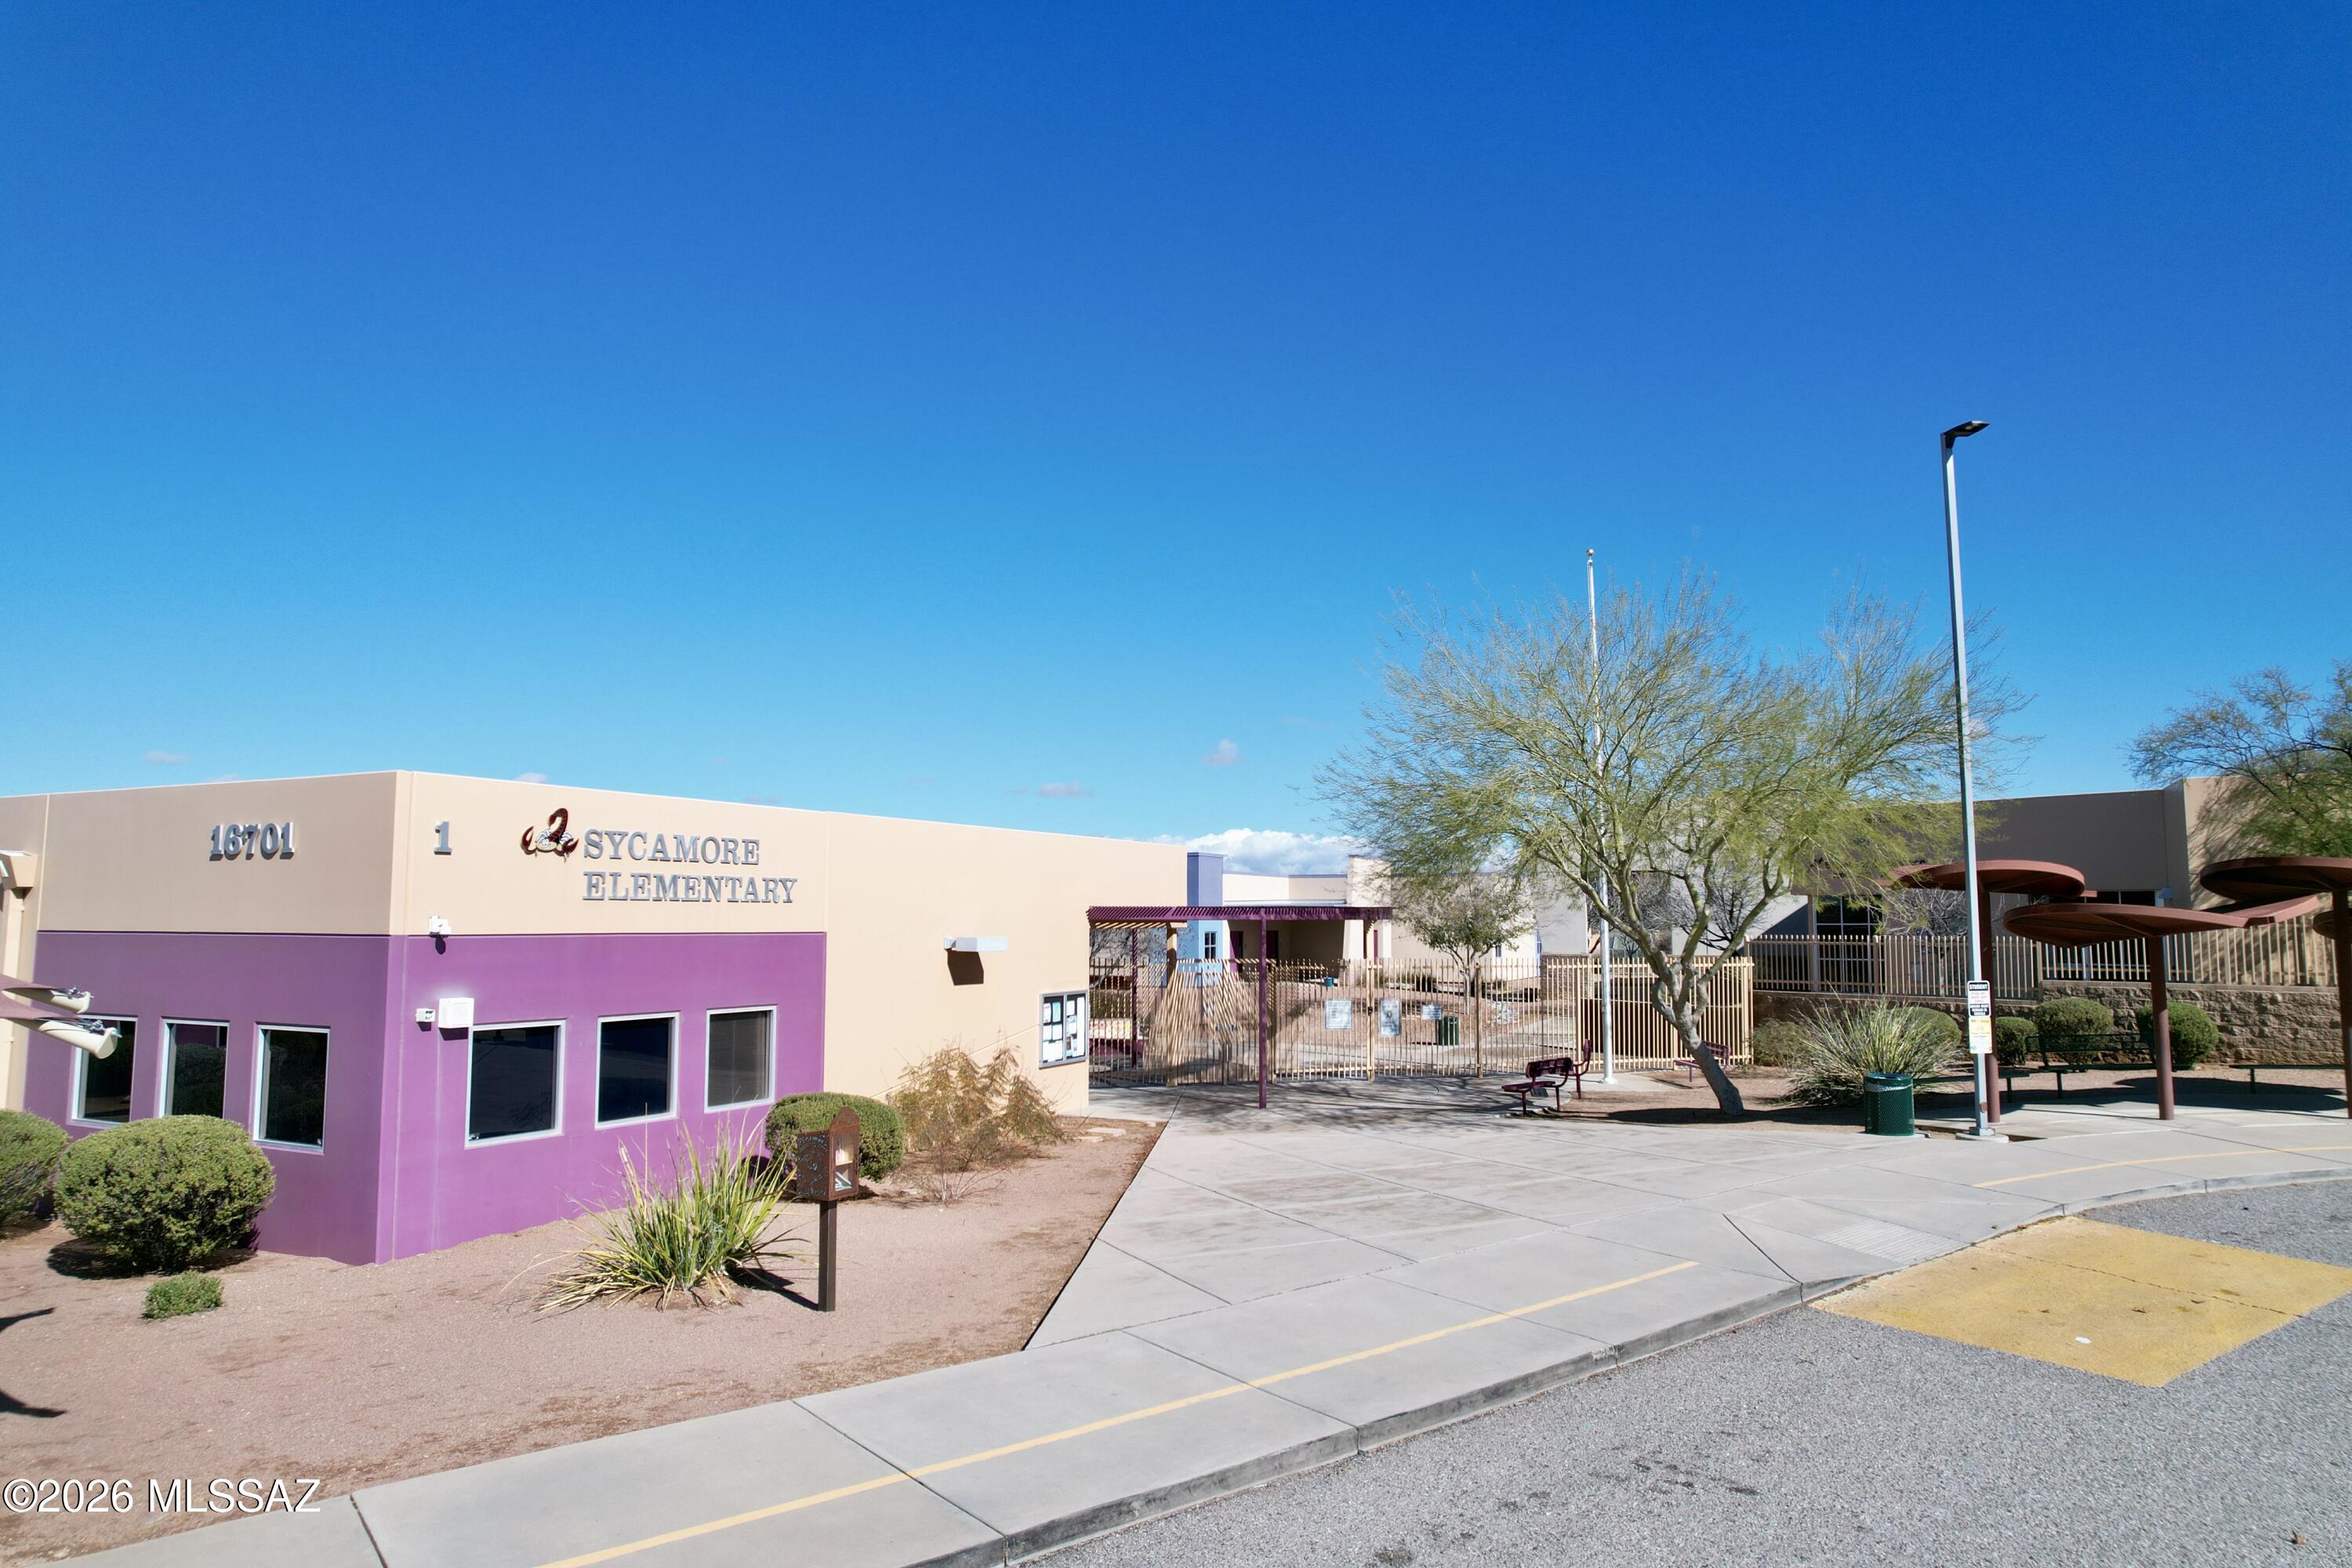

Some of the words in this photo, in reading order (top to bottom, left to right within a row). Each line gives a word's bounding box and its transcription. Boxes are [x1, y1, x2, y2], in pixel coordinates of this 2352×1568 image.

[210, 822, 295, 857] 16701
[434, 821, 452, 855] 1
[583, 829, 760, 865] SYCAMORE
[583, 871, 797, 903] ELEMENTARY
